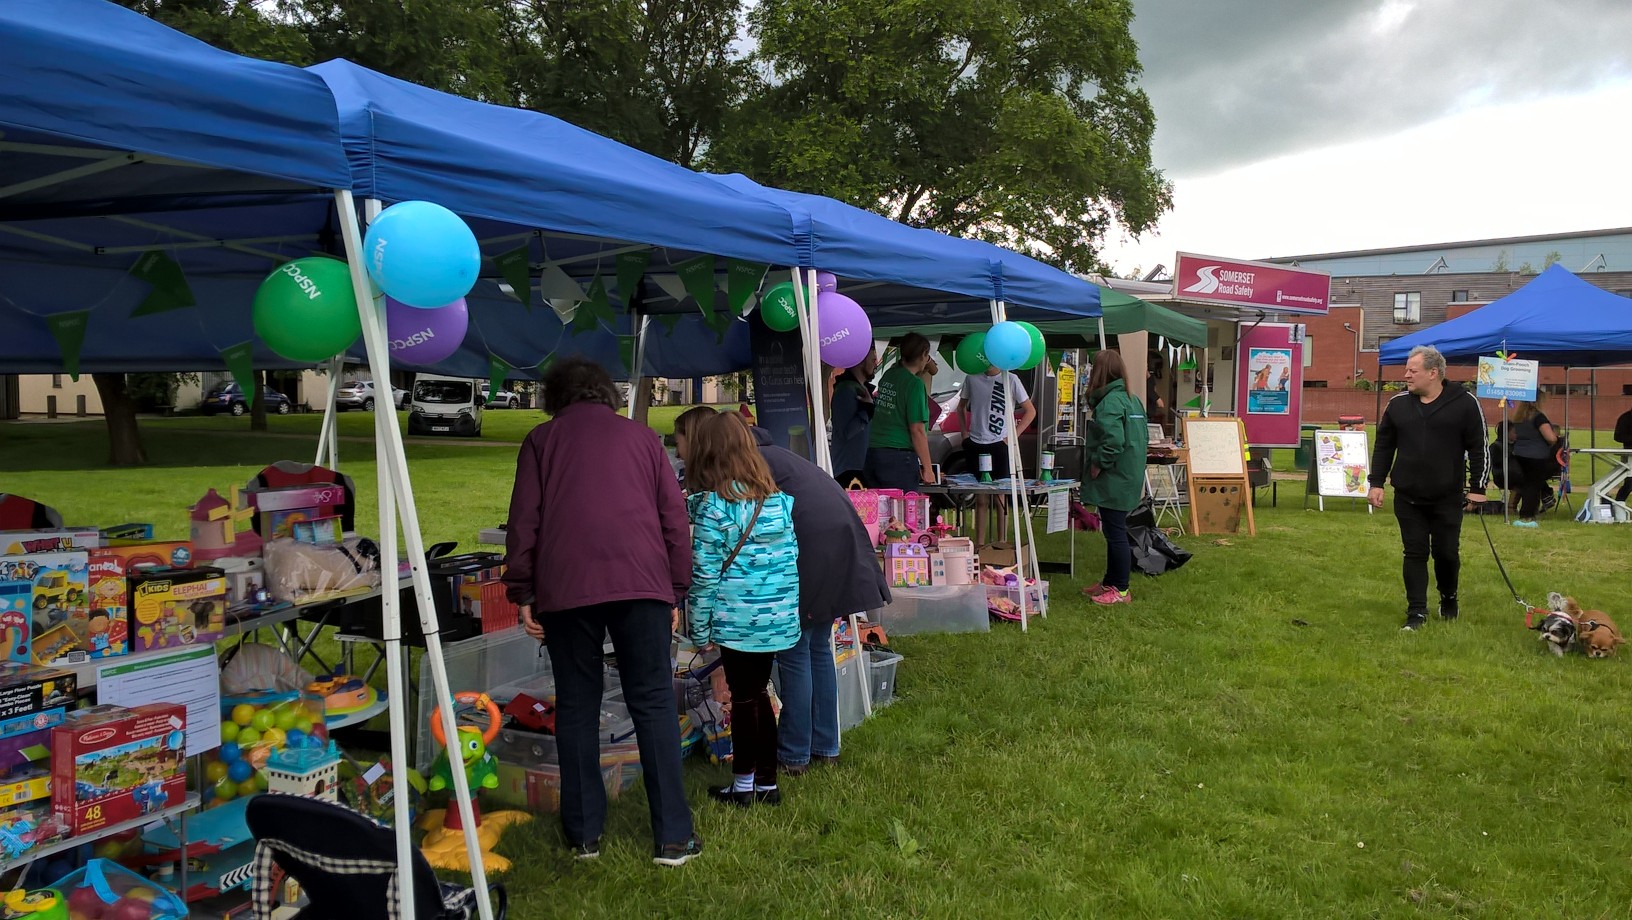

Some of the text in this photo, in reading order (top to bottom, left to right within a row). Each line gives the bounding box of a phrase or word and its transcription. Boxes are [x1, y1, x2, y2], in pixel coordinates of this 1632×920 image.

[282, 263, 322, 300] NSPCC
[1219, 270, 1255, 284] SOMERSET
[1218, 283, 1254, 298] Road Safety
[777, 296, 797, 318] NSPCC
[388, 327, 435, 350] NSPCC
[820, 327, 850, 347] NSPCC
[991, 380, 1006, 416] NIKE
[989, 413, 1004, 435] SB
[148, 584, 170, 594] KIDS
[173, 583, 207, 596] ELEPHA
[14, 704, 33, 713] Feet!
[85, 805, 101, 820] 48
